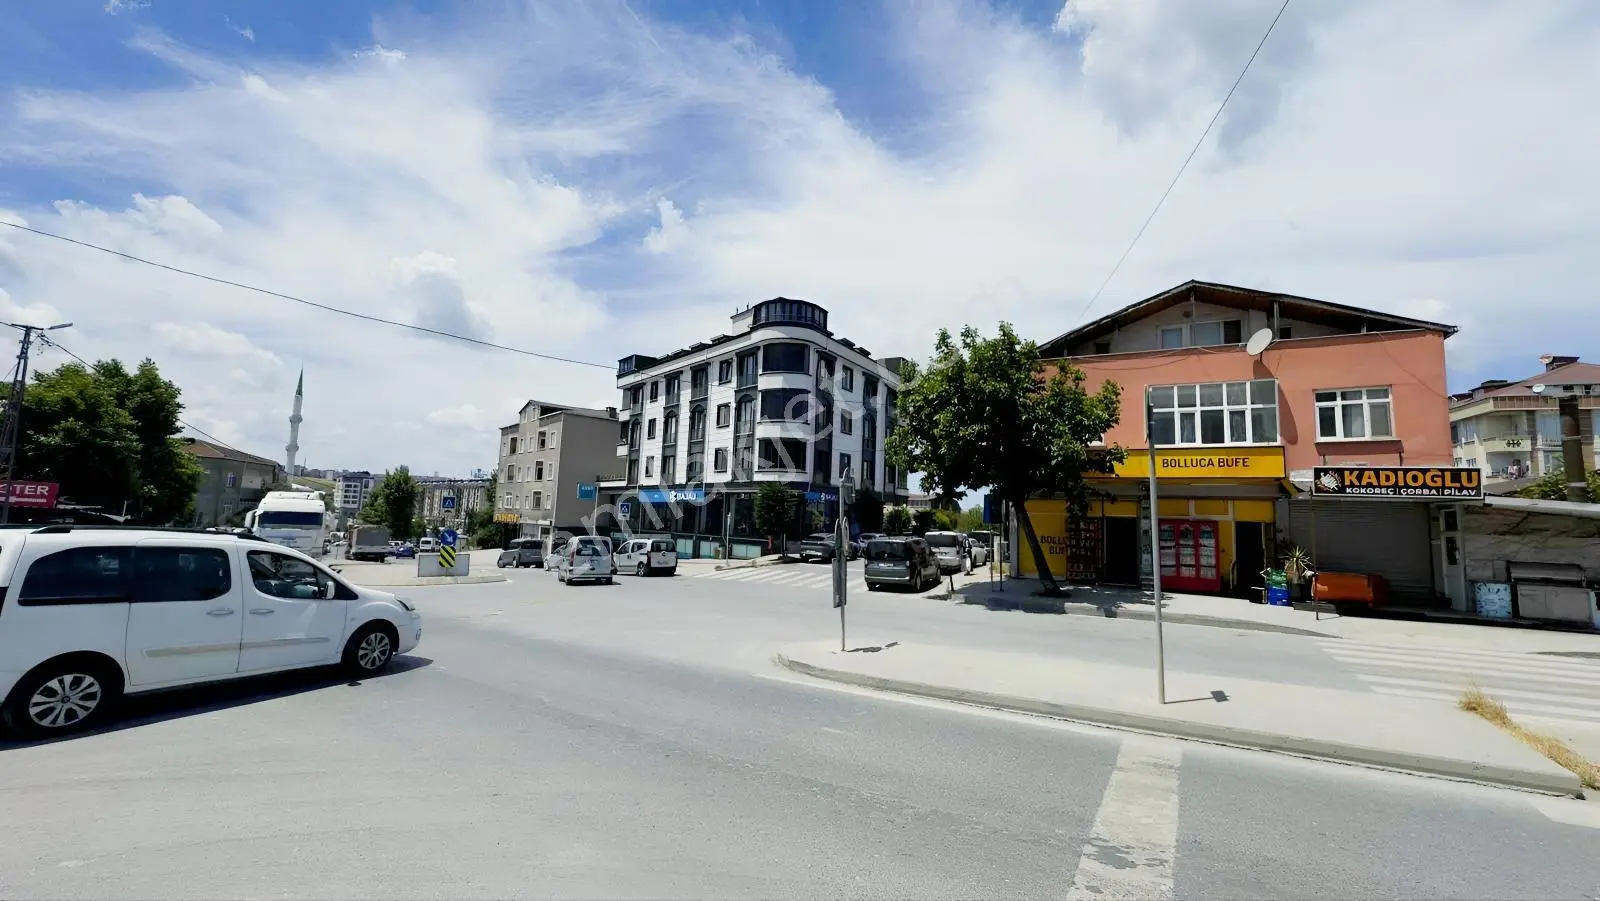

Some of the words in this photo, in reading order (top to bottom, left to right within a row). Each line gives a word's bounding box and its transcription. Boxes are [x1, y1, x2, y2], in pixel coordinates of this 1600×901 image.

[1162, 457, 1215, 468] BOLLUCA
[1344, 469, 1479, 488] KADIOĞLU
[1346, 487, 1394, 495] KOKOREÇ
[1400, 487, 1438, 496] ÇORBA
[1444, 487, 1477, 496] PİLAV
